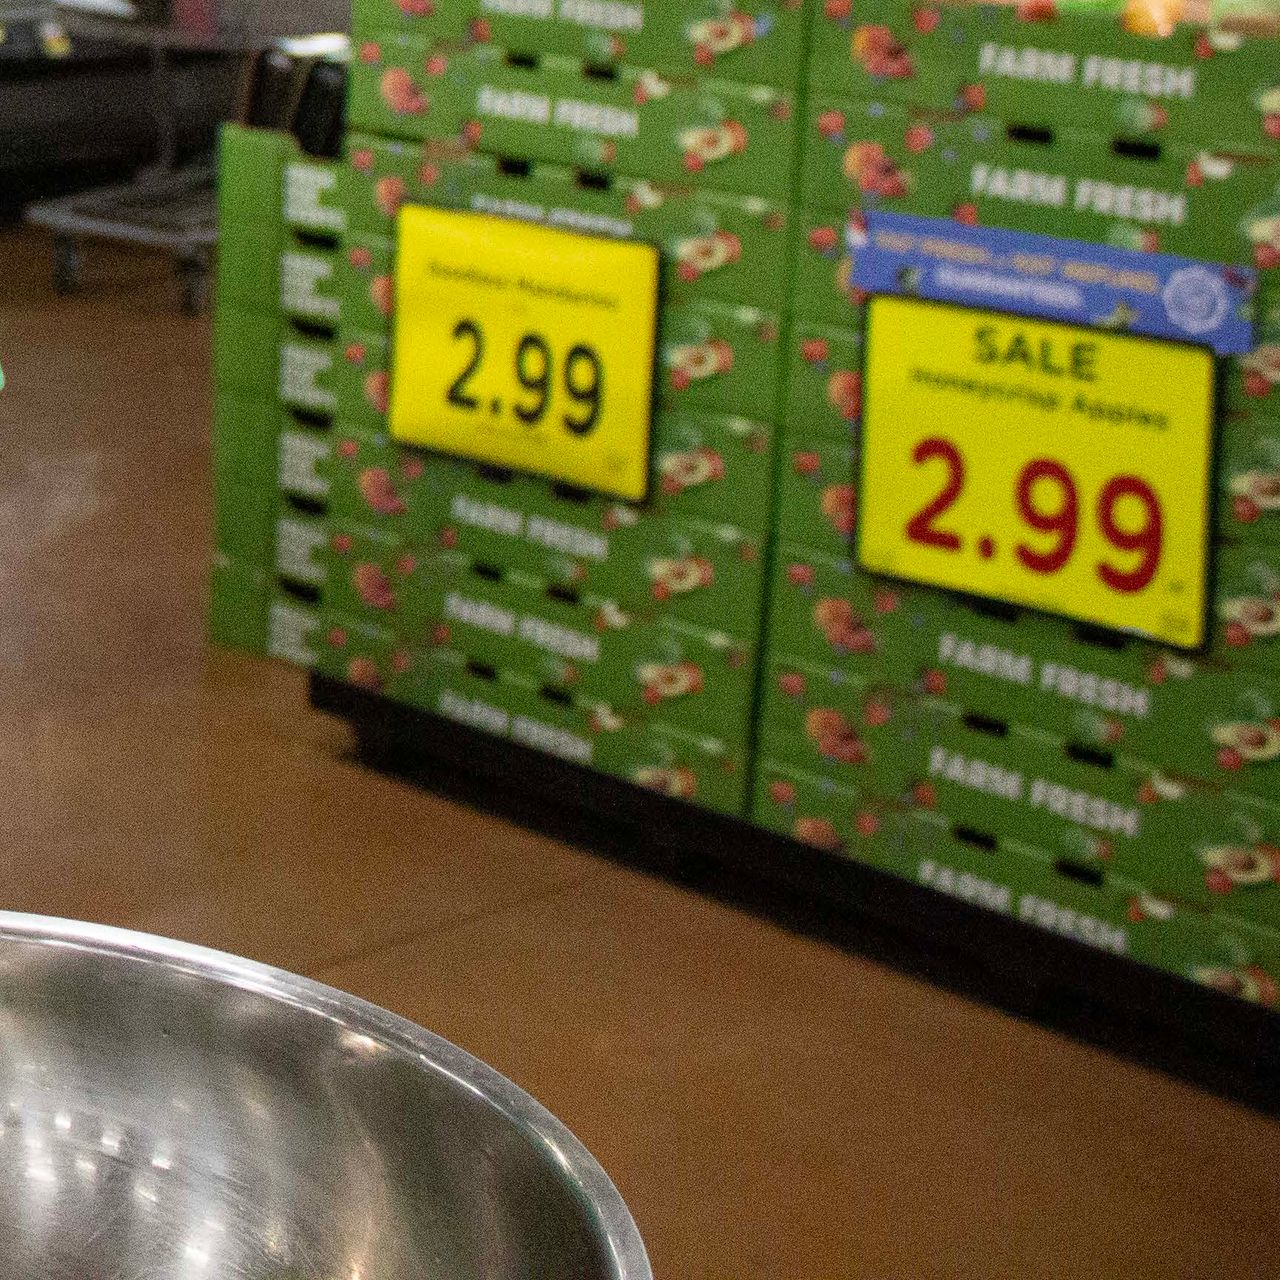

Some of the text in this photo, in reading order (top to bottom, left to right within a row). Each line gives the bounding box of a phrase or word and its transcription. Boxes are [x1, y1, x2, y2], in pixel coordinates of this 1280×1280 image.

[979, 41, 1196, 99] FARM FRESH
[477, 85, 638, 136] FARM FRESH
[970, 163, 1188, 225] FARM FRESH
[445, 317, 603, 438] 2.99
[974, 326, 1100, 381] SALE
[905, 436, 1164, 595] 2.99
[939, 633, 1149, 717] FARM FRESH
[929, 746, 1140, 837] FARM FRESH
